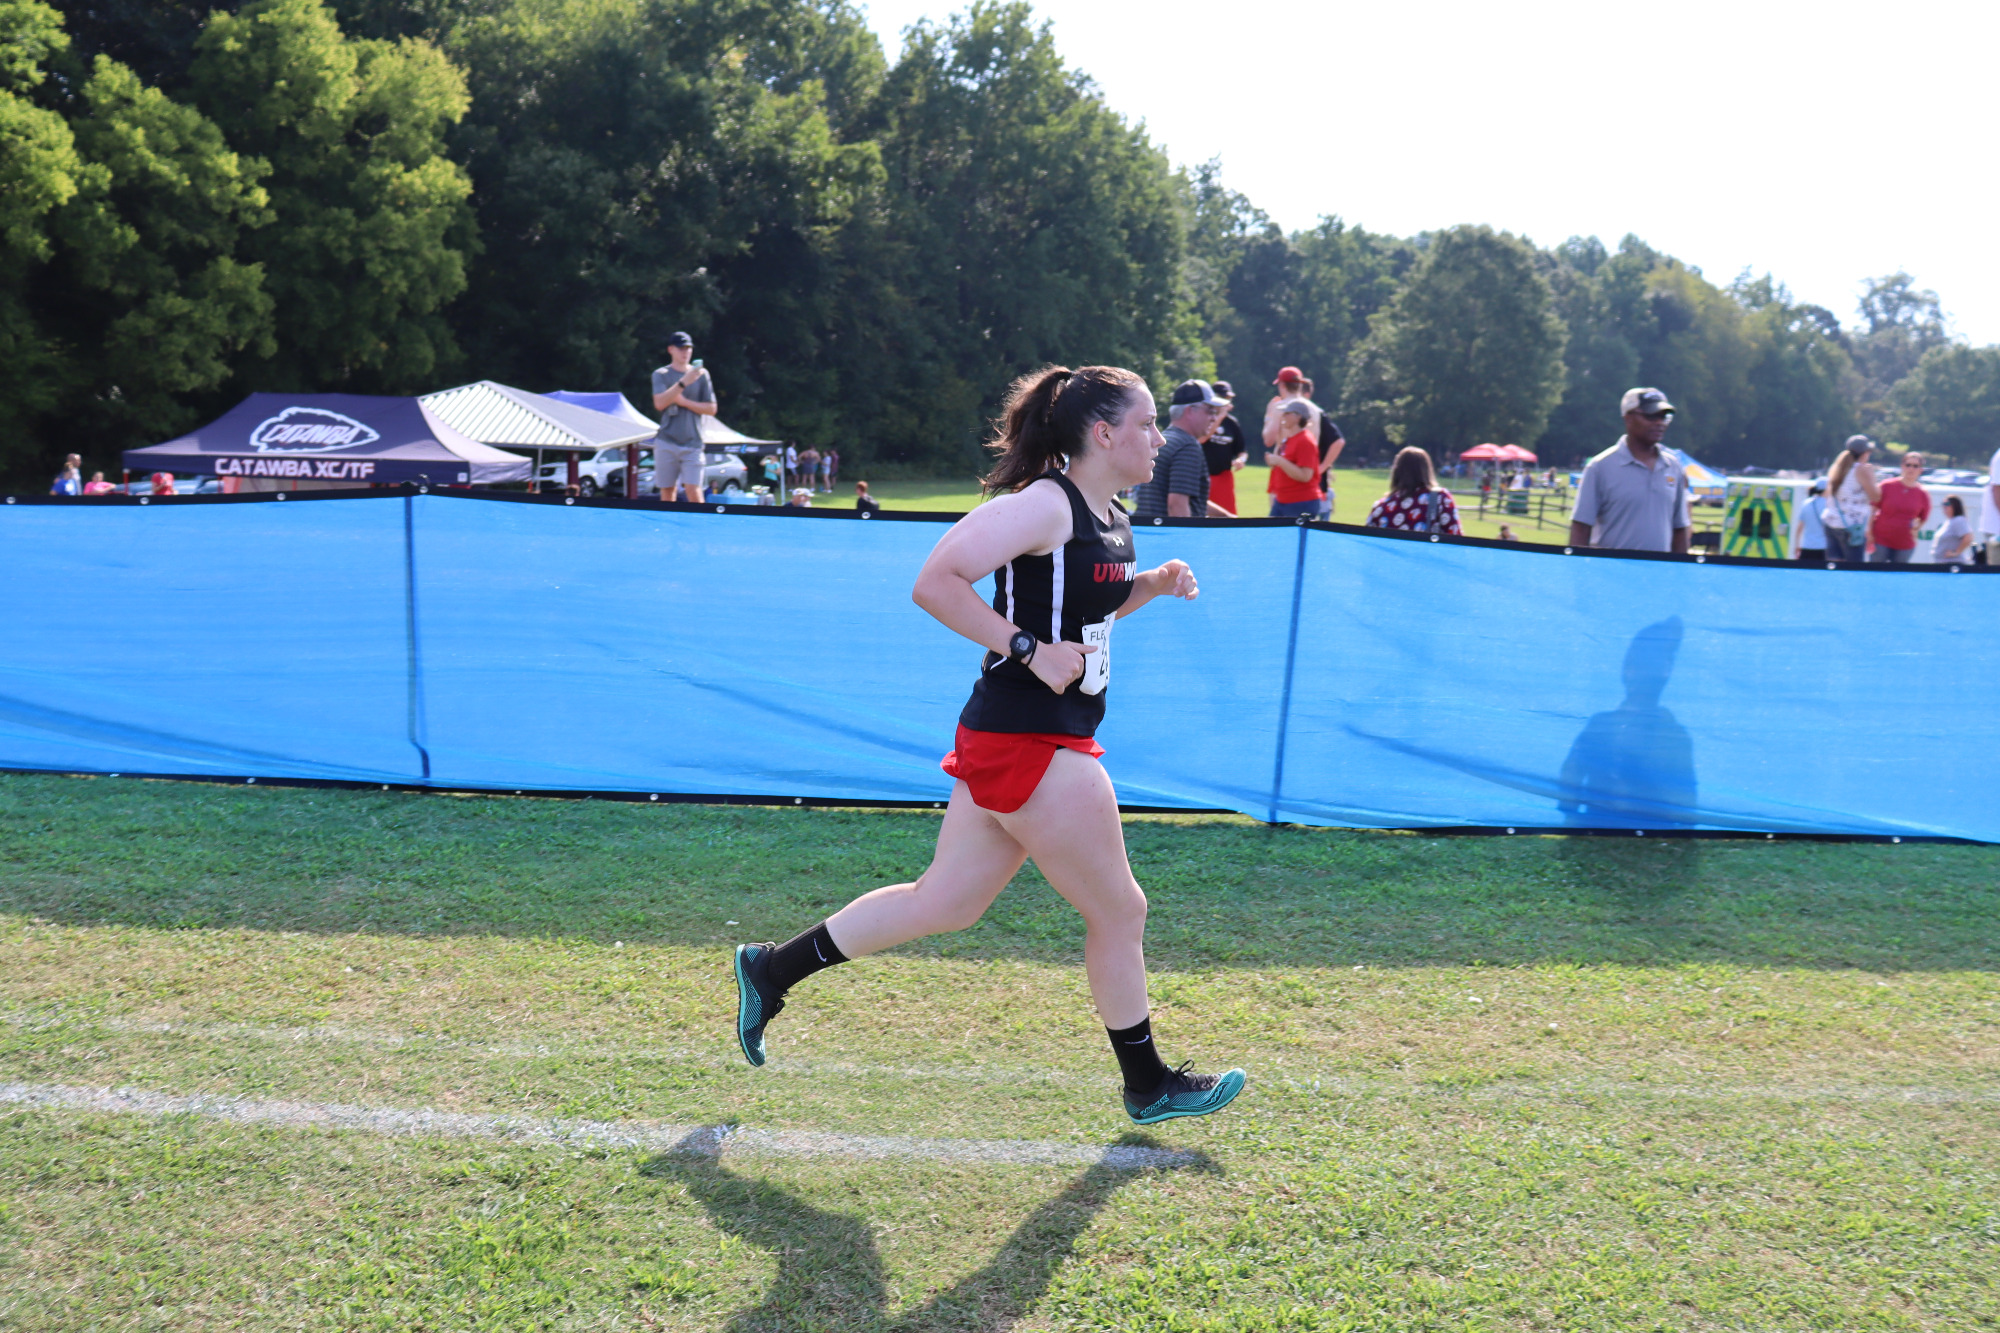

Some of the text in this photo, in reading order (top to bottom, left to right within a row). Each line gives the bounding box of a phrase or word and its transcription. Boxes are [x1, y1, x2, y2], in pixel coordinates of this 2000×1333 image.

[261, 424, 360, 445] CATAWBA
[215, 458, 375, 479] CATAWBA XC/TF
